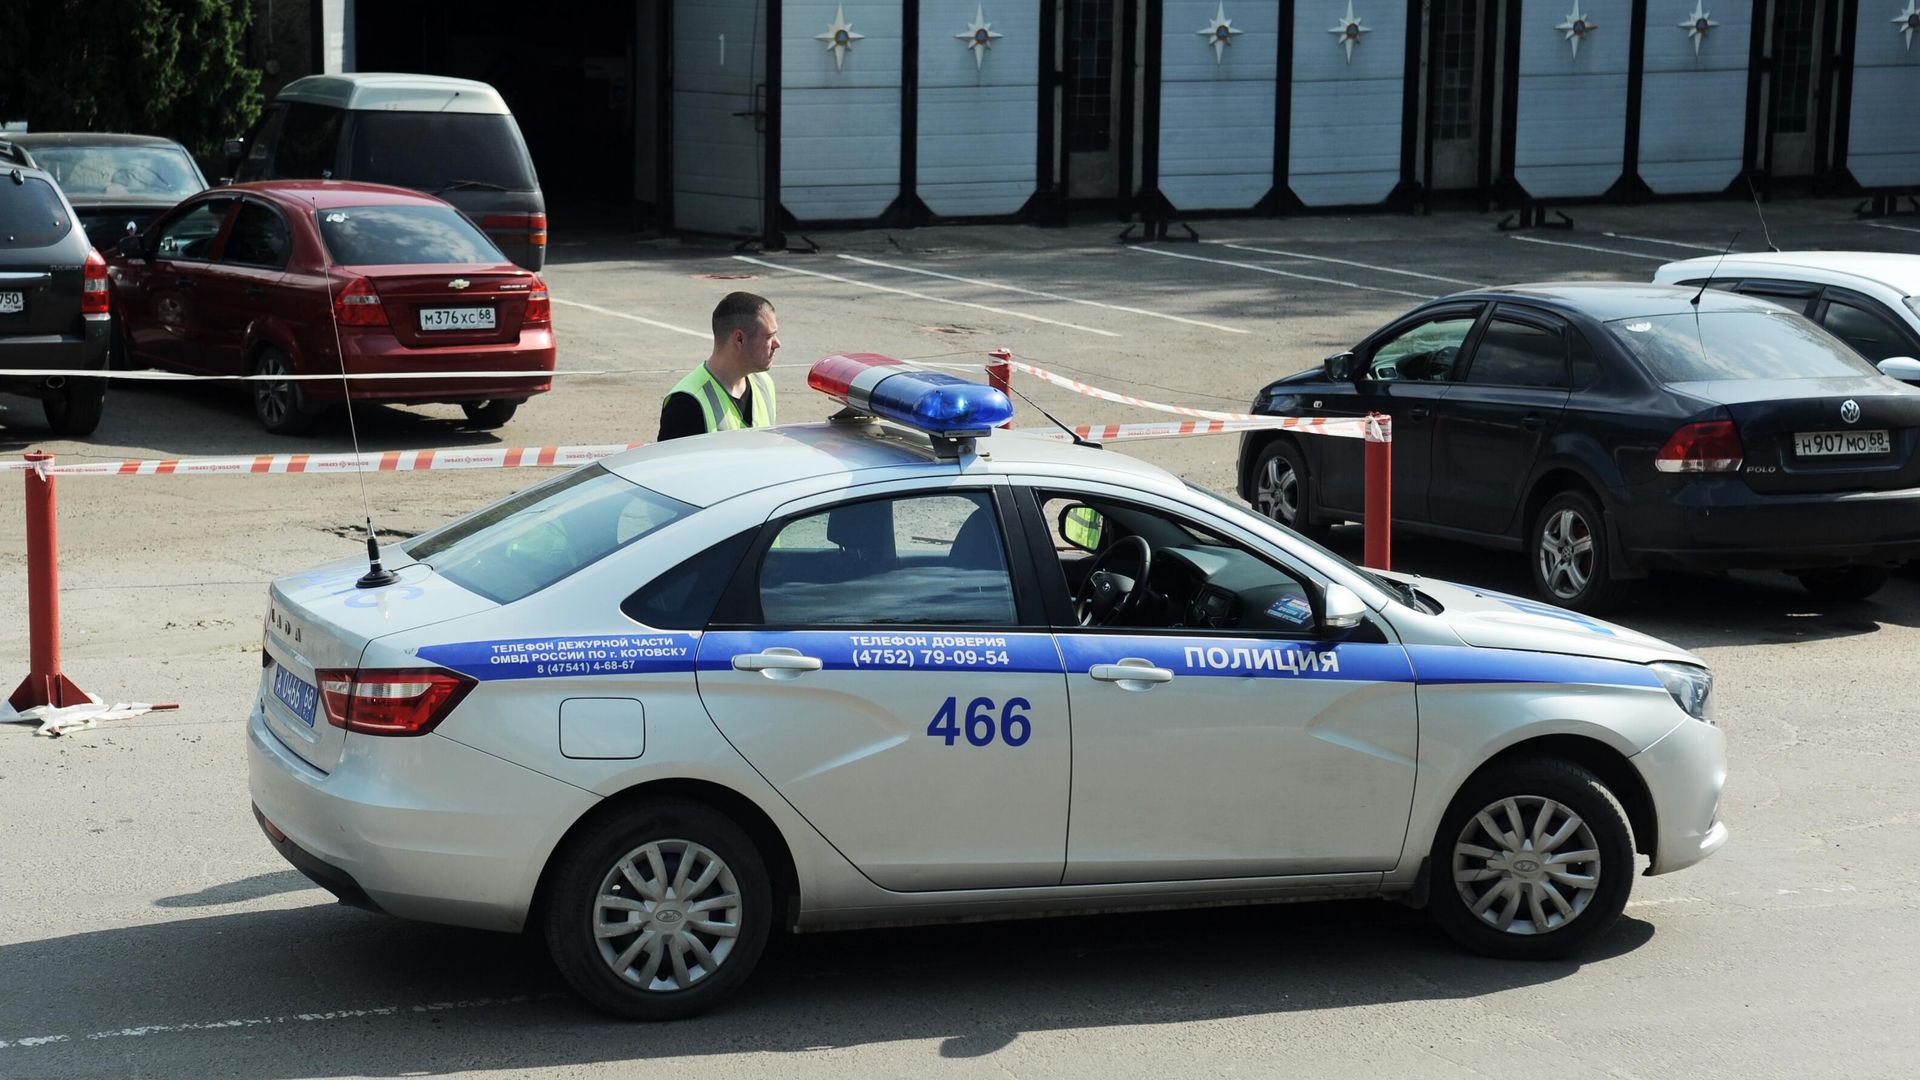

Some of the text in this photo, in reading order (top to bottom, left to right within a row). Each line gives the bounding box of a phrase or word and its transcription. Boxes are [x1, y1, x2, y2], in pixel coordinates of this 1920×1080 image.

[492, 637, 674, 653] ТЕЛЕФОН ДЕЖУРНОЙ ЧАСТИ
[850, 636, 1007, 648] ТЕЛЕФОН ДОВЕРИЯ
[490, 653, 529, 665] ОМВД
[532, 650, 585, 662] РОССИИ
[588, 650, 607, 659] ПО
[609, 651, 618, 659] г.
[852, 649, 1010, 667] (4752) 79-09-54
[1183, 646, 1340, 675] ПОЛИЦИЯ
[537, 660, 636, 674] 8 (47541) 4-68-67
[927, 696, 1032, 747] 466
